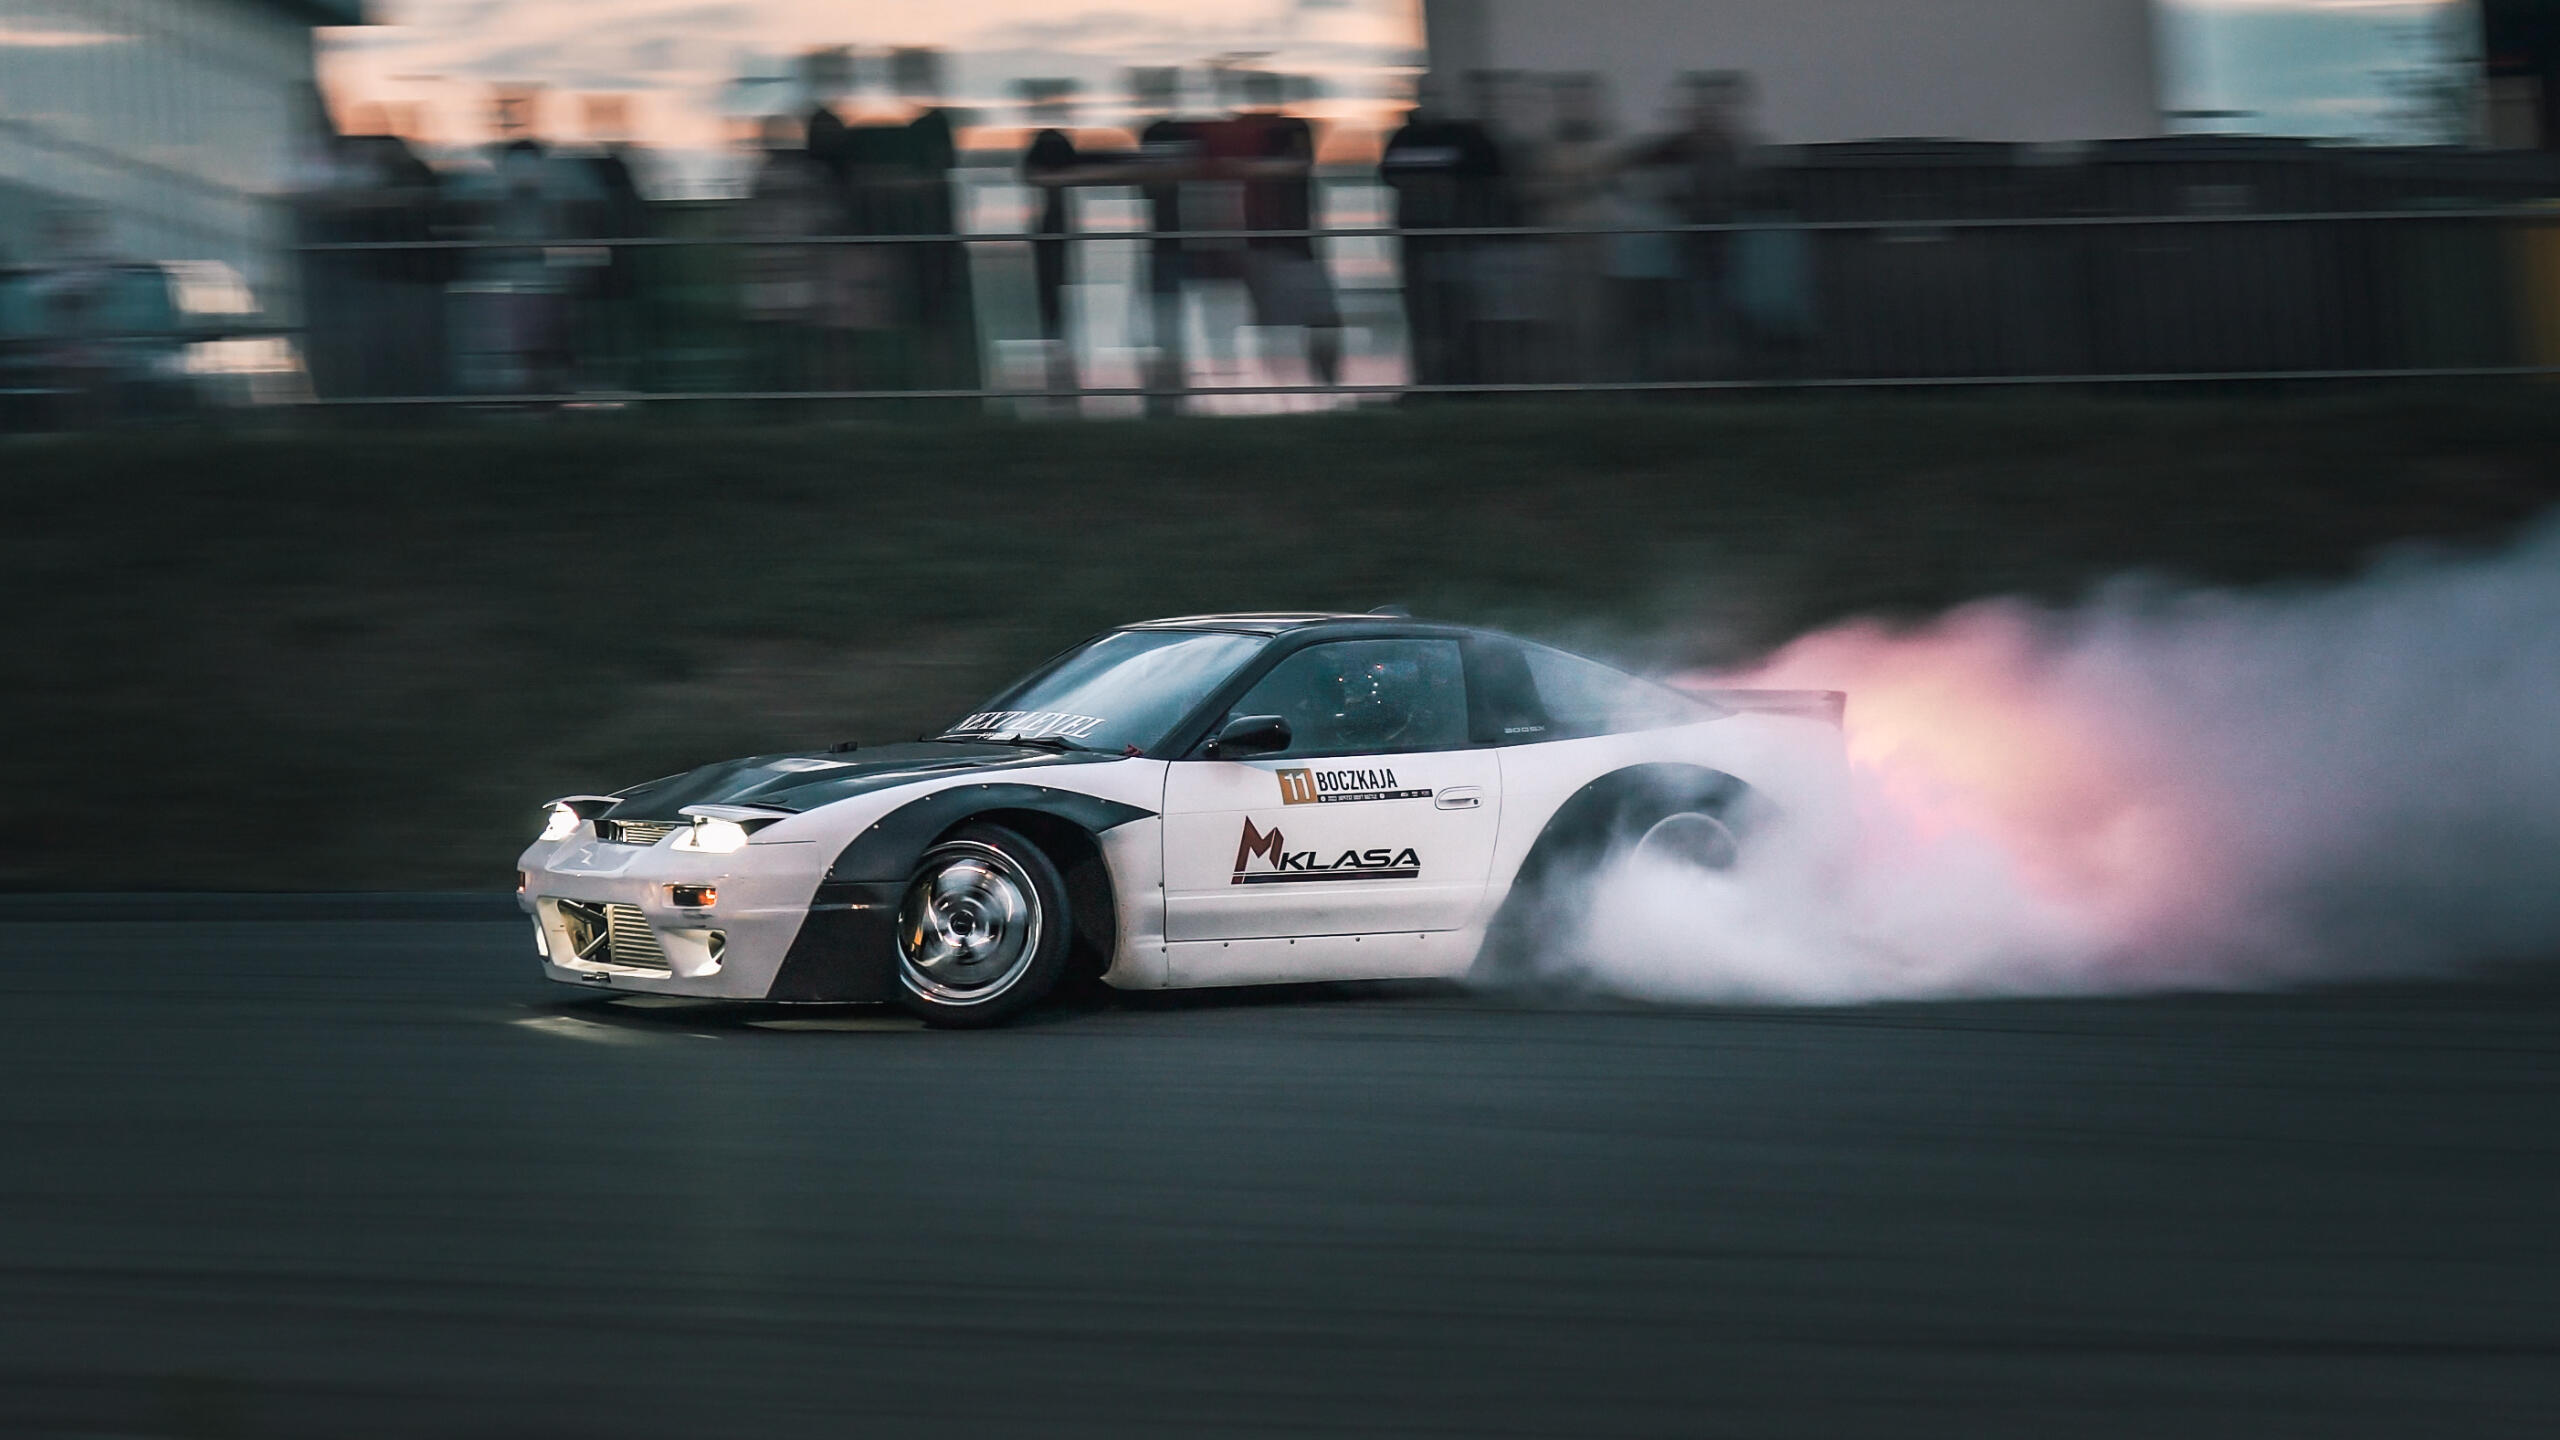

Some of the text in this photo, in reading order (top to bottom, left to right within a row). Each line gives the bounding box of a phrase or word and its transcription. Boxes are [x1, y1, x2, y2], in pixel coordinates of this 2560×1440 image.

[1005, 711, 1106, 739] LEVEL
[1284, 768, 1398, 801] 11 BOCZKAJA
